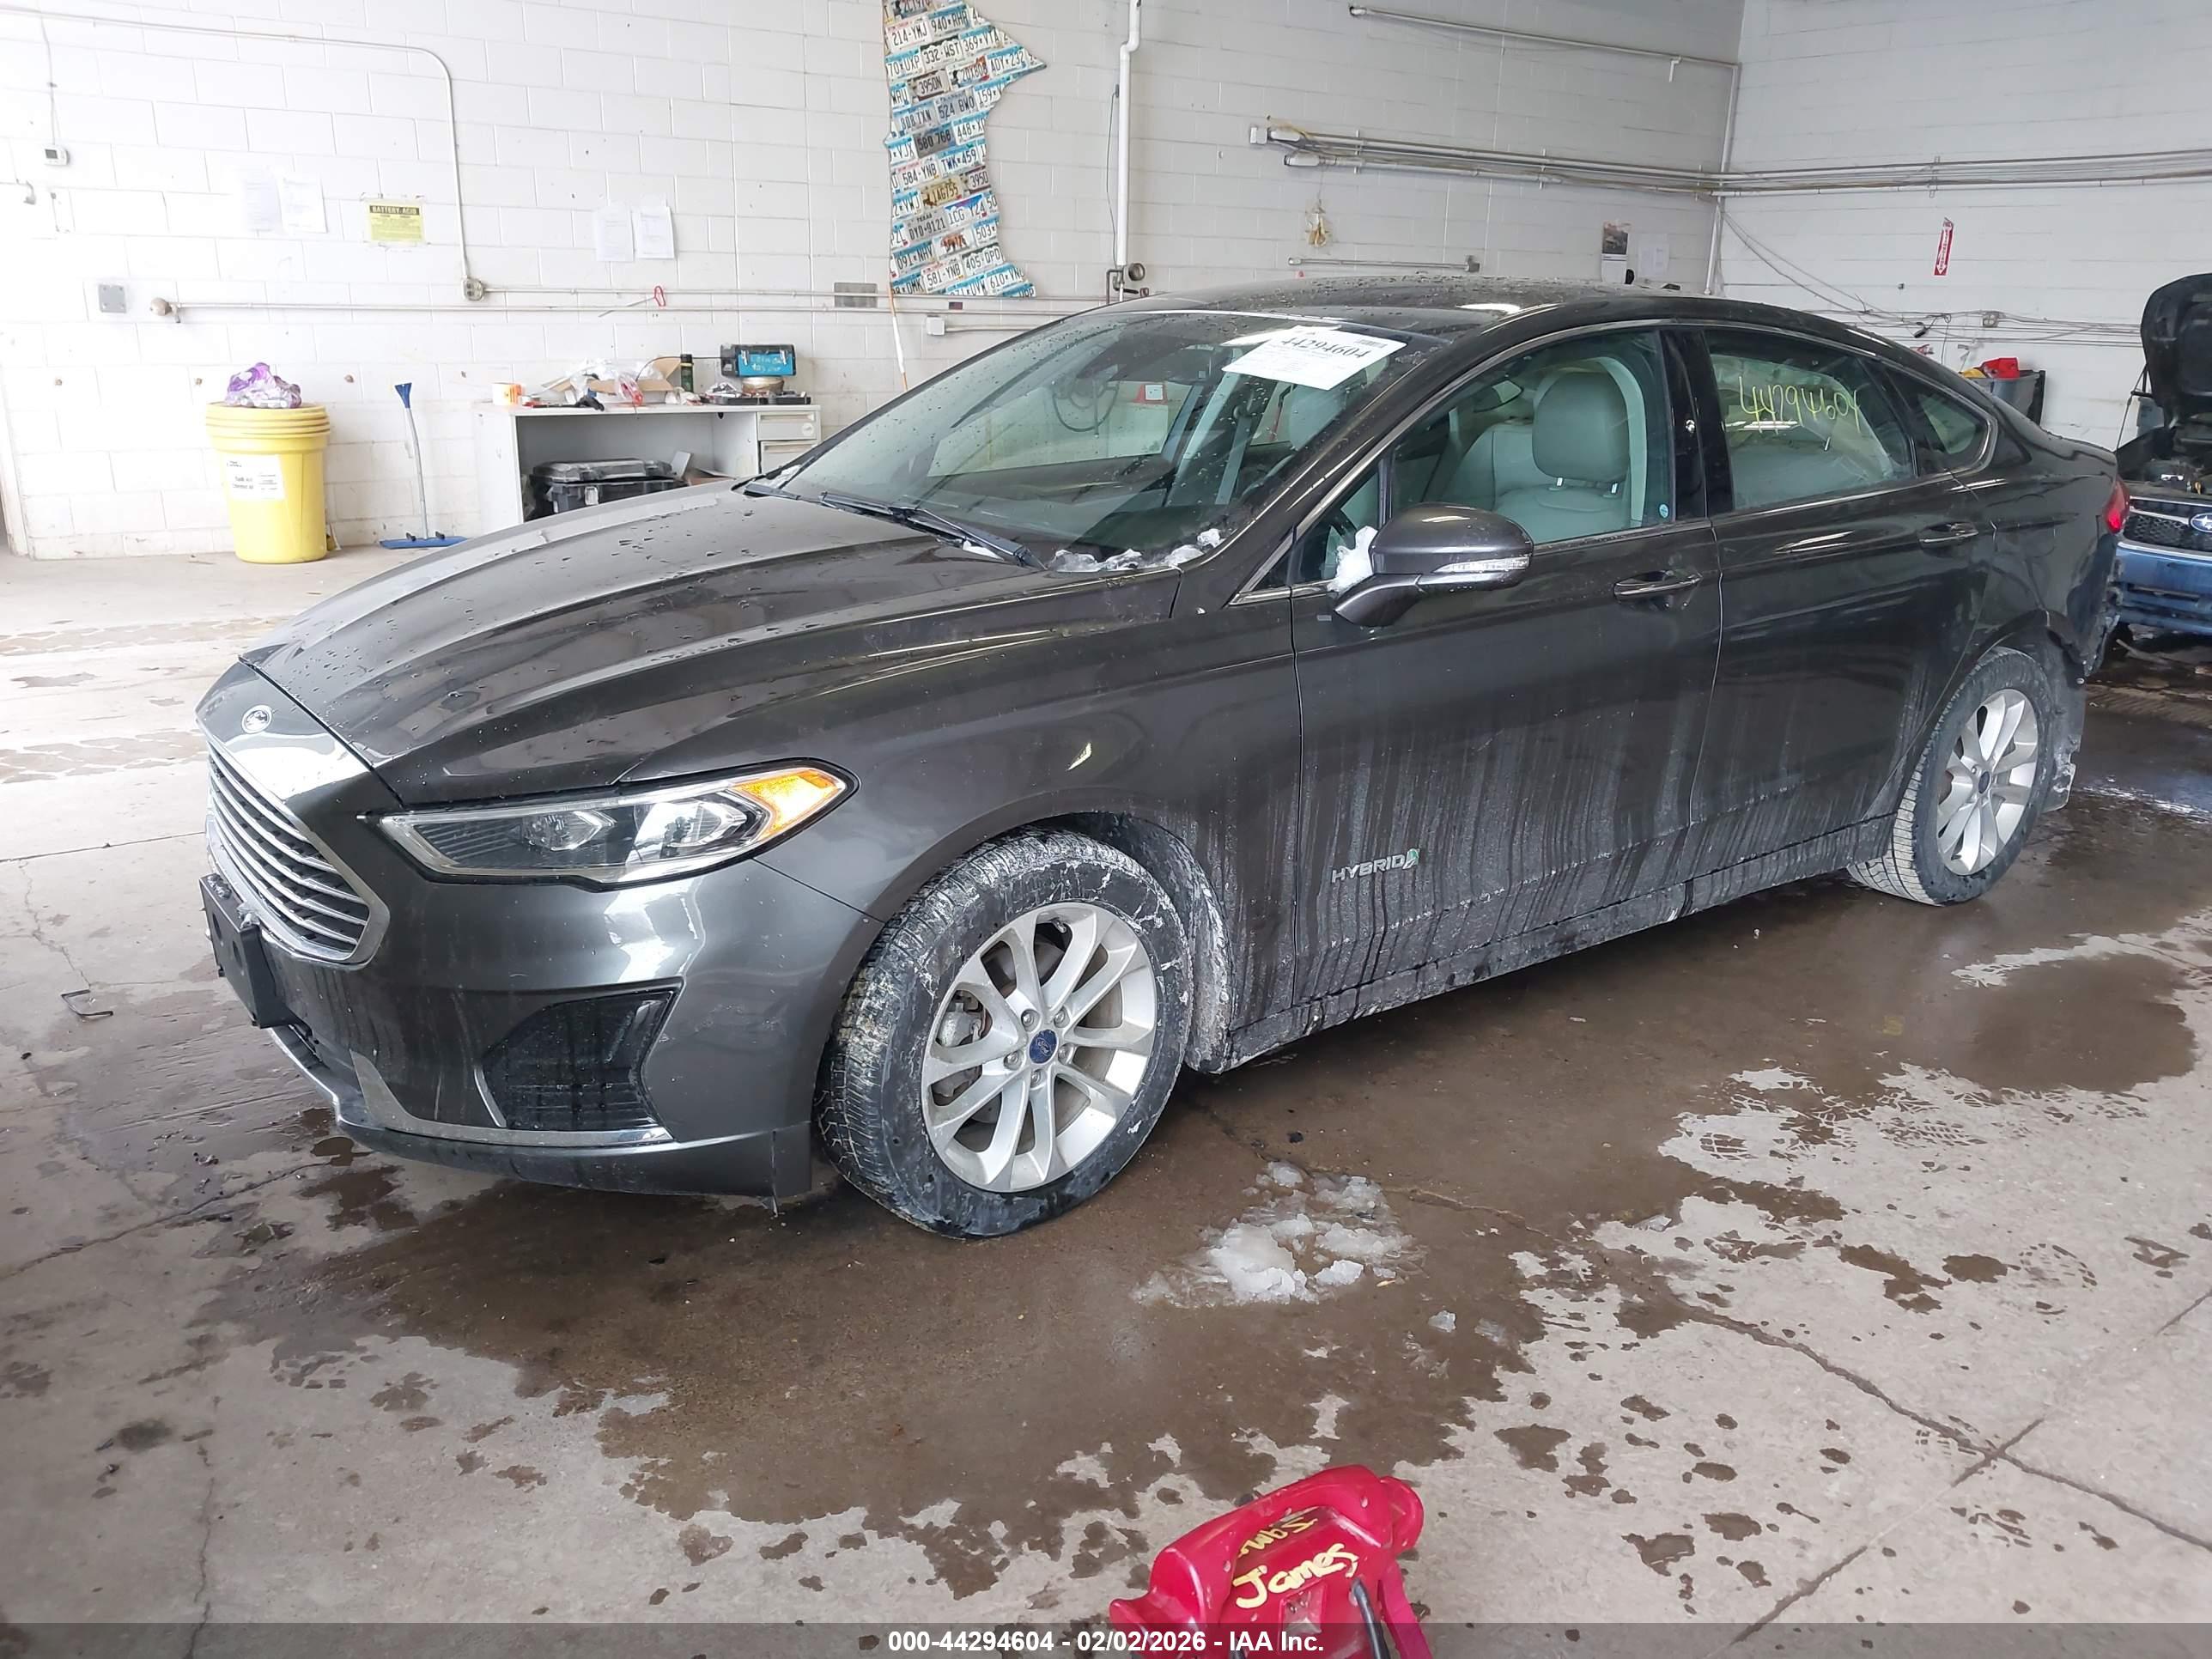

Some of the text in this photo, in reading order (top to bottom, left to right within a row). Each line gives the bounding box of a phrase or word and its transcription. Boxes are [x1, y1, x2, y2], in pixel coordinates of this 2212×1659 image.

[1281, 336, 1372, 358] 44294604
[1331, 854, 1406, 884] HYBRID
[1232, 1543, 1359, 1609] James
